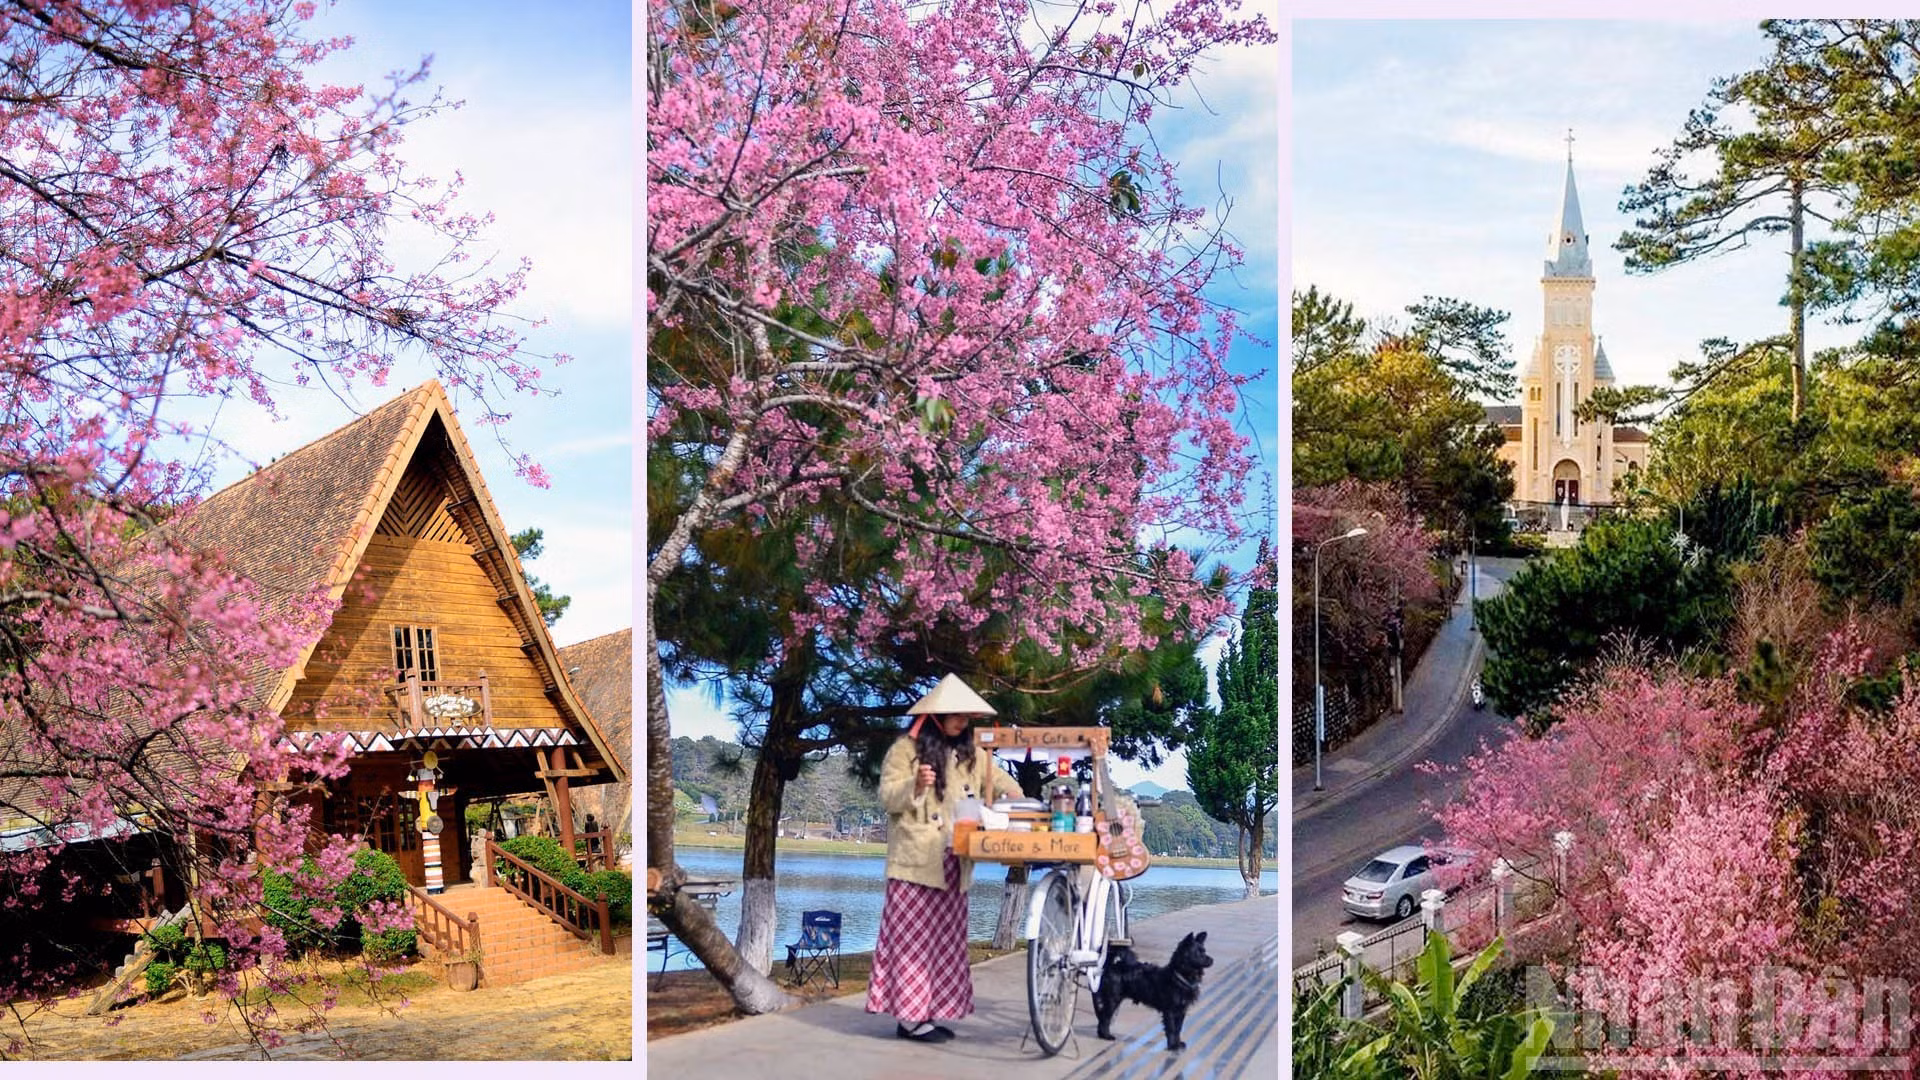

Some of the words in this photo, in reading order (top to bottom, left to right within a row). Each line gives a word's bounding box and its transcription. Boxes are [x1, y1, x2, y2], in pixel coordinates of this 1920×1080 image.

[981, 836, 1024, 854] Coffee
[1032, 842, 1042, 854] &
[1050, 837, 1079, 853] More
